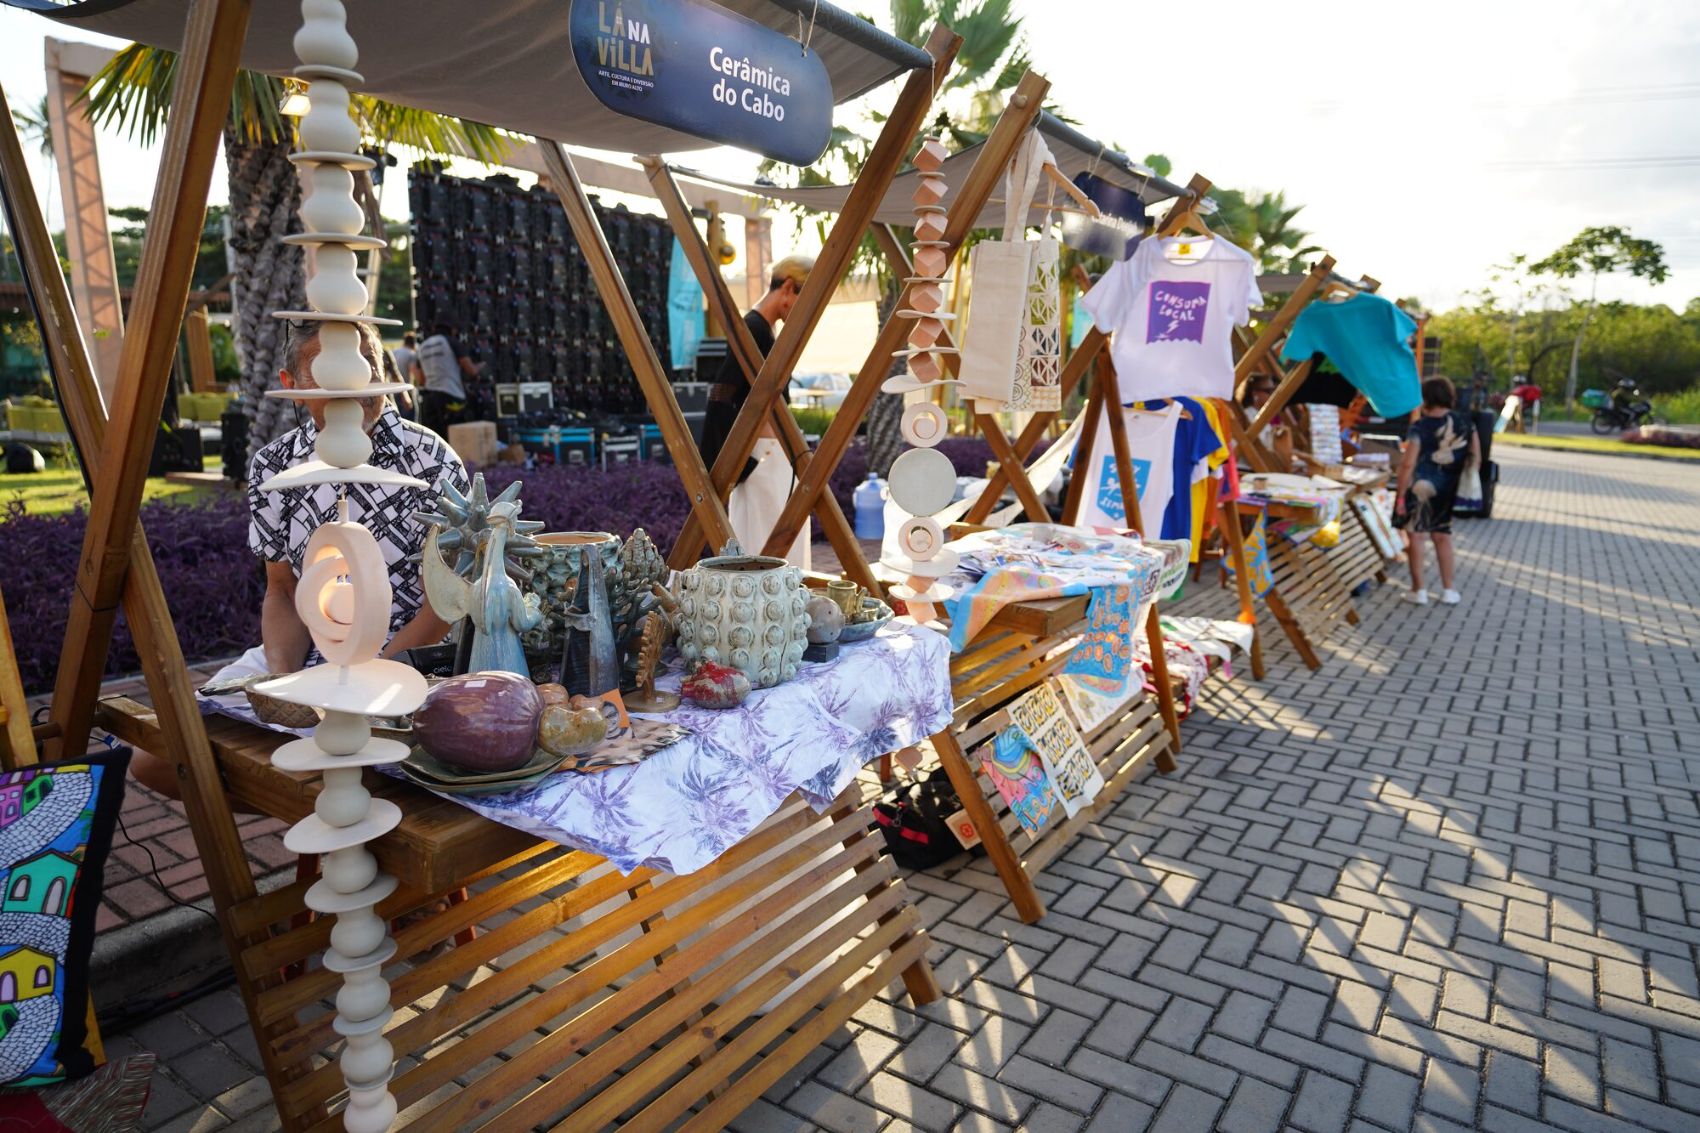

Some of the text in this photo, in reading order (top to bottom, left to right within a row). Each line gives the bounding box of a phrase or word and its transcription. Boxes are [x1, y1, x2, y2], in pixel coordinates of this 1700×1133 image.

[628, 19, 650, 44] NA
[709, 46, 791, 96] Cerâmica
[712, 78, 785, 122] do Cabo
[1159, 304, 1195, 321] LOCAL
